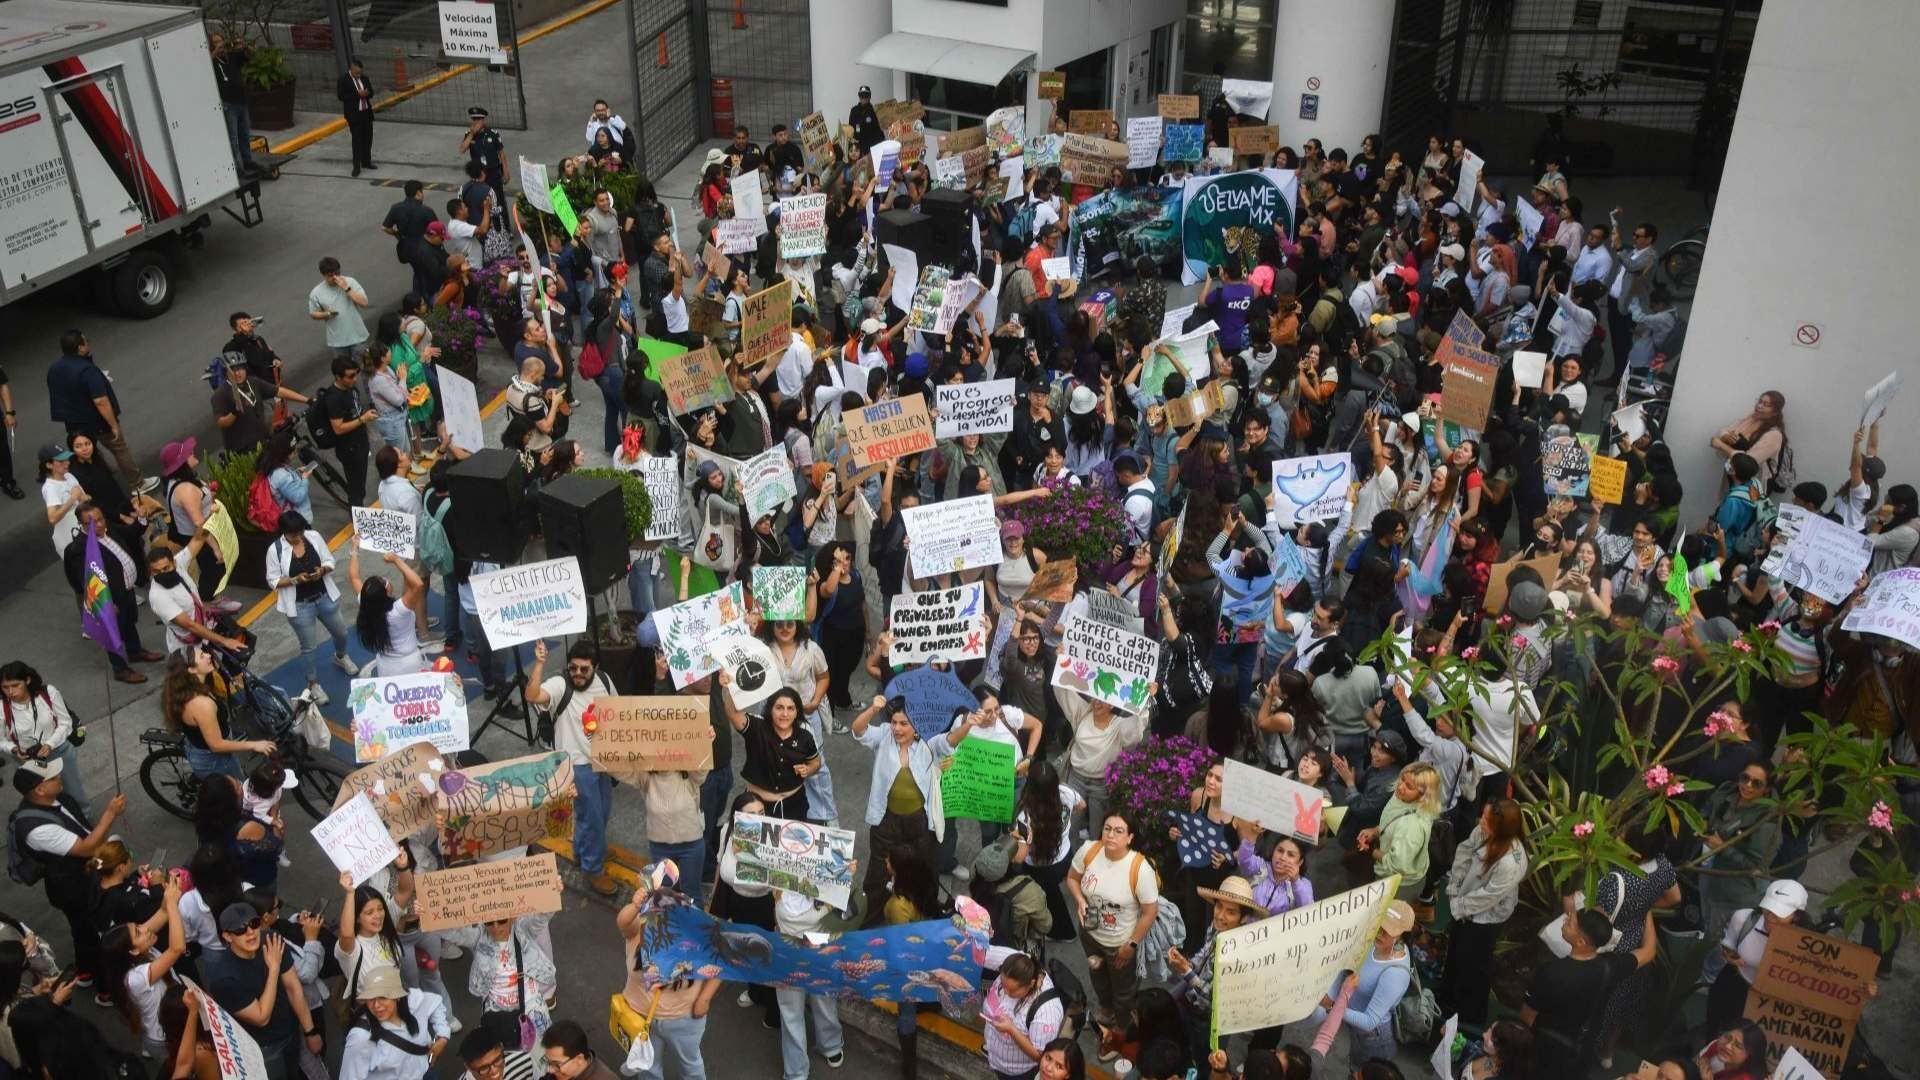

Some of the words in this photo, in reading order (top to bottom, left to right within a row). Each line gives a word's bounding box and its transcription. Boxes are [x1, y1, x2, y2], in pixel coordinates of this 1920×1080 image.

[445, 13, 492, 24] Velocidad
[450, 28, 488, 38] Máxima
[445, 42, 457, 51] 10
[35, 156, 63, 175] EVENTO
[22, 167, 65, 190] COMPROMISO
[781, 200, 794, 213] EN
[782, 213, 792, 224] NO
[1249, 207, 1273, 225] MX
[744, 294, 767, 317] VALE
[756, 312, 766, 321] EL
[748, 336, 761, 351] QUE
[939, 389, 960, 401] NO
[862, 399, 903, 424] HASTA
[952, 394, 1012, 414] progreso
[952, 406, 1000, 421] destruye
[975, 414, 1008, 428] VIDA!
[848, 425, 868, 443] QUE
[871, 414, 927, 438] PUBLIQUEN
[850, 444, 866, 458] LA
[649, 458, 669, 471] QUE
[917, 592, 940, 606] QUE
[945, 589, 962, 604] TU
[500, 592, 573, 623] MAHAHUAL
[893, 625, 932, 638] NUNCA
[895, 641, 912, 652] TU
[1068, 644, 1079, 659] EL
[894, 679, 914, 693] NO
[393, 699, 441, 720] CORALES
[598, 708, 615, 723] NO
[619, 709, 632, 721] ES
[635, 708, 697, 721] PROGRESO
[408, 715, 424, 725] NO
[386, 719, 452, 740] TOBOGANES
[610, 728, 668, 743] DESTRUYE
[684, 732, 703, 741] QUE
[374, 747, 417, 780] vende
[598, 751, 620, 762] NOS
[628, 751, 644, 761] DA
[422, 873, 470, 887] Alcaldesa
[427, 889, 438, 897] es
[441, 885, 451, 895] la
[454, 877, 505, 893] responsable
[514, 872, 526, 882] del
[429, 901, 440, 909] de
[442, 905, 466, 920] Royal
[1797, 936, 1841, 960] SON
[1767, 964, 1863, 1007] ECOCIDIOS
[1757, 997, 1769, 1010] Y
[1772, 1001, 1796, 1018] NO
[1799, 1008, 1843, 1030] SOLO
[1757, 1015, 1846, 1049] AMENAZAN
